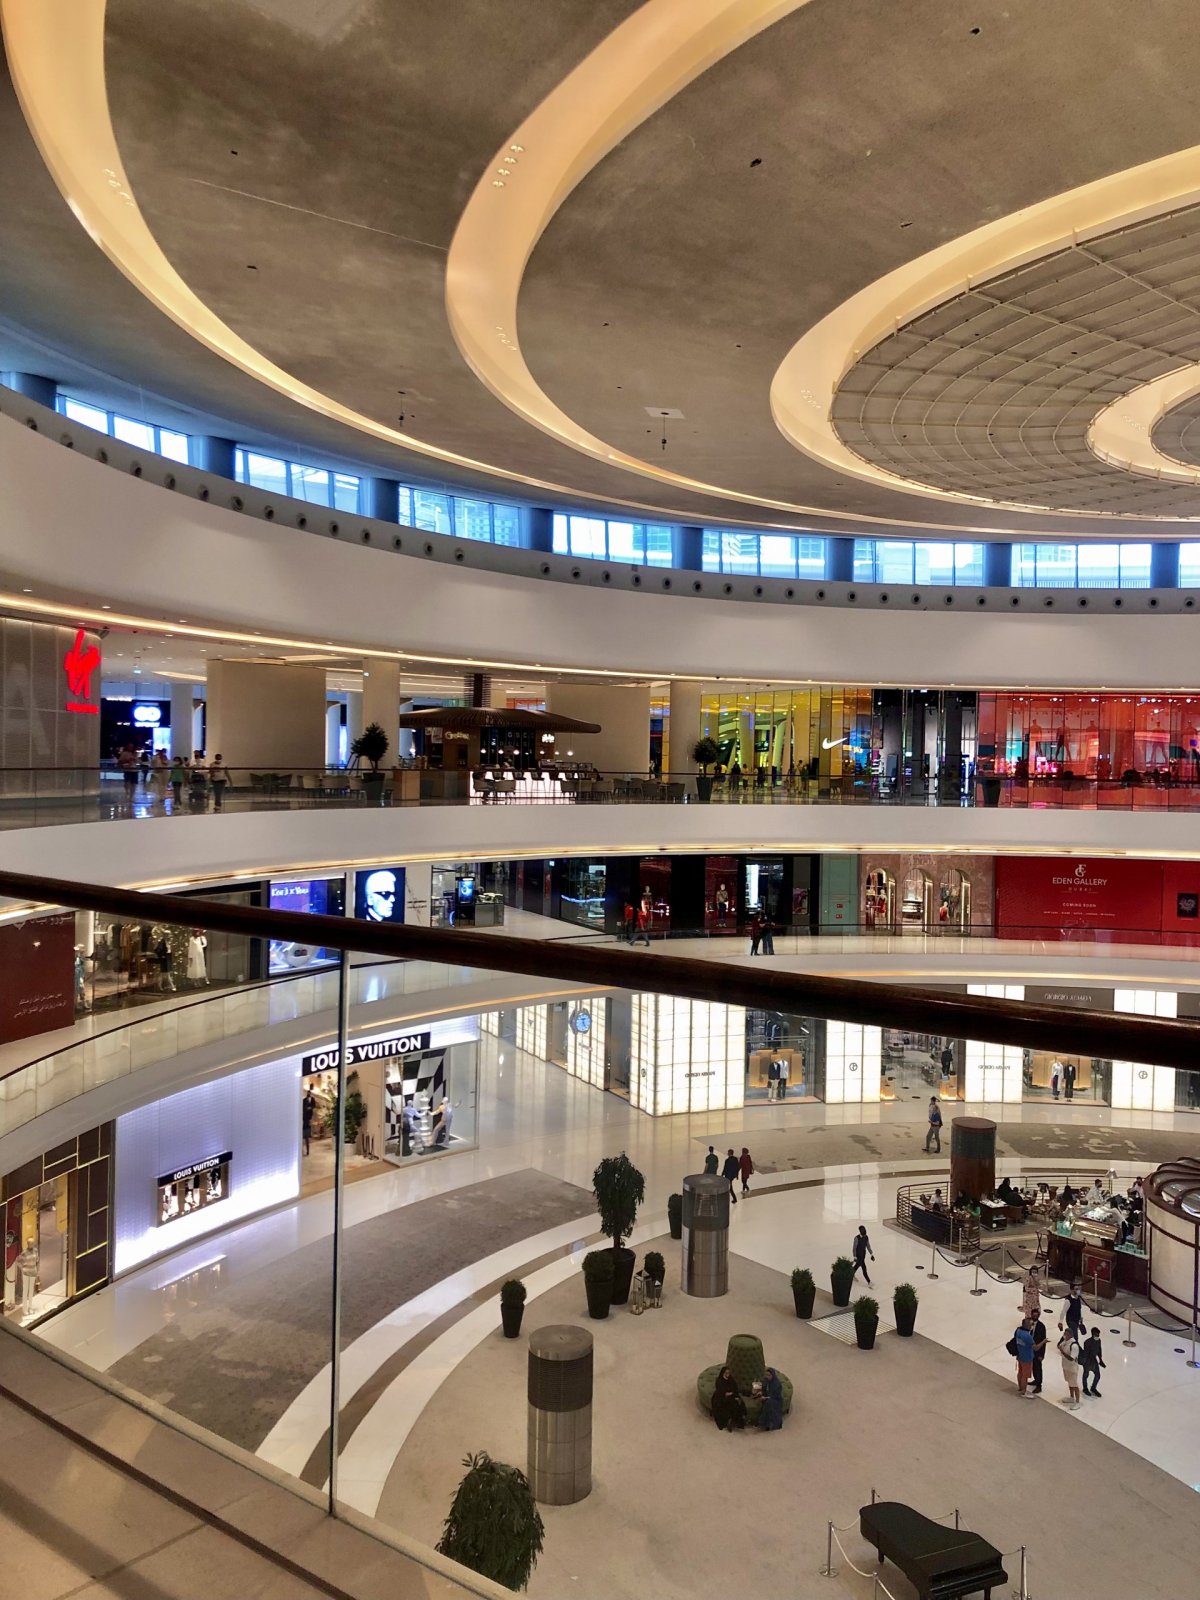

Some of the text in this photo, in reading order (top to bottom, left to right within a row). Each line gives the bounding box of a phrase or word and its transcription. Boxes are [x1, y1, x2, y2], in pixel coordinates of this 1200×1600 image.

[1052, 877, 1108, 886] EDEN GALLERY
[311, 1035, 422, 1072] LOUS VUITTON
[173, 1157, 220, 1181] LOUIS VUITTON
